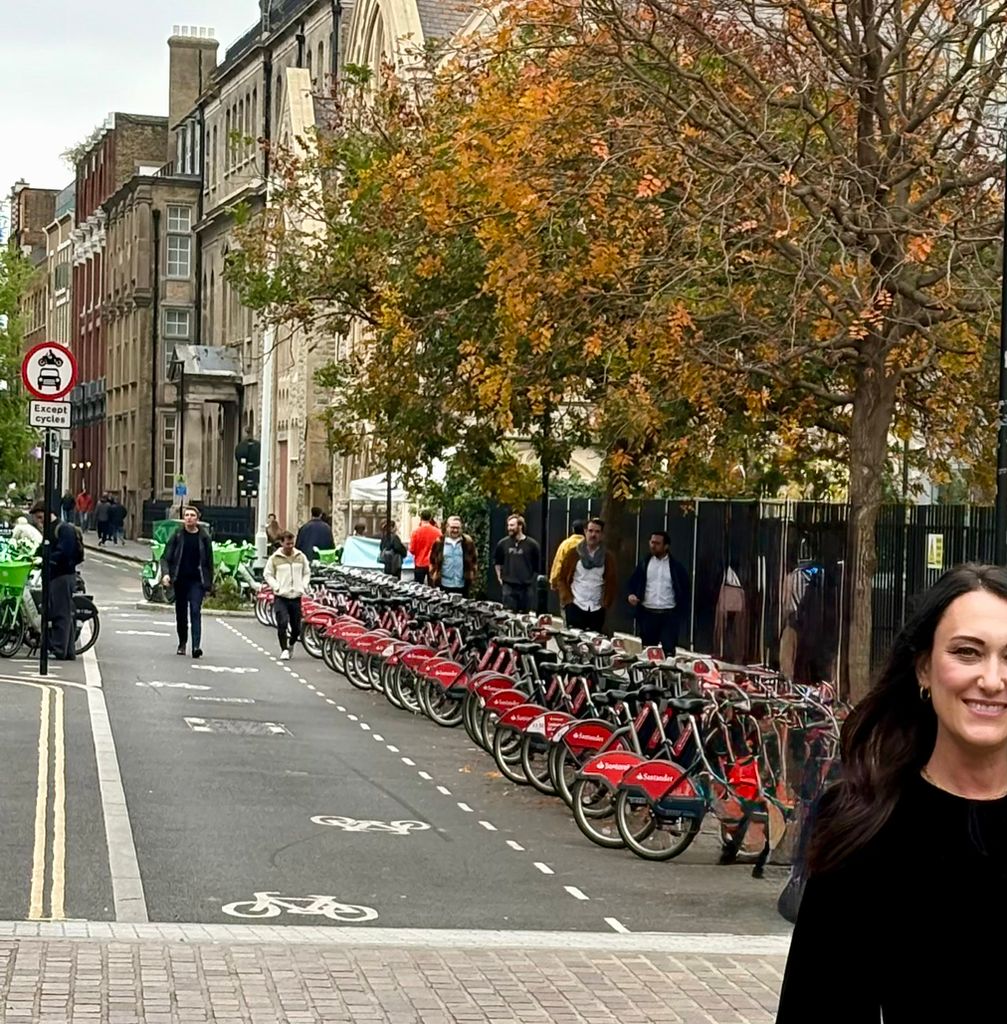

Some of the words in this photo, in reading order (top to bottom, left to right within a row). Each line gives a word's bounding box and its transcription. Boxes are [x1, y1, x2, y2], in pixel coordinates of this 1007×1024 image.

[34, 404, 67, 414] Except
[35, 415, 65, 424] cycles
[643, 772, 674, 782] Santander
